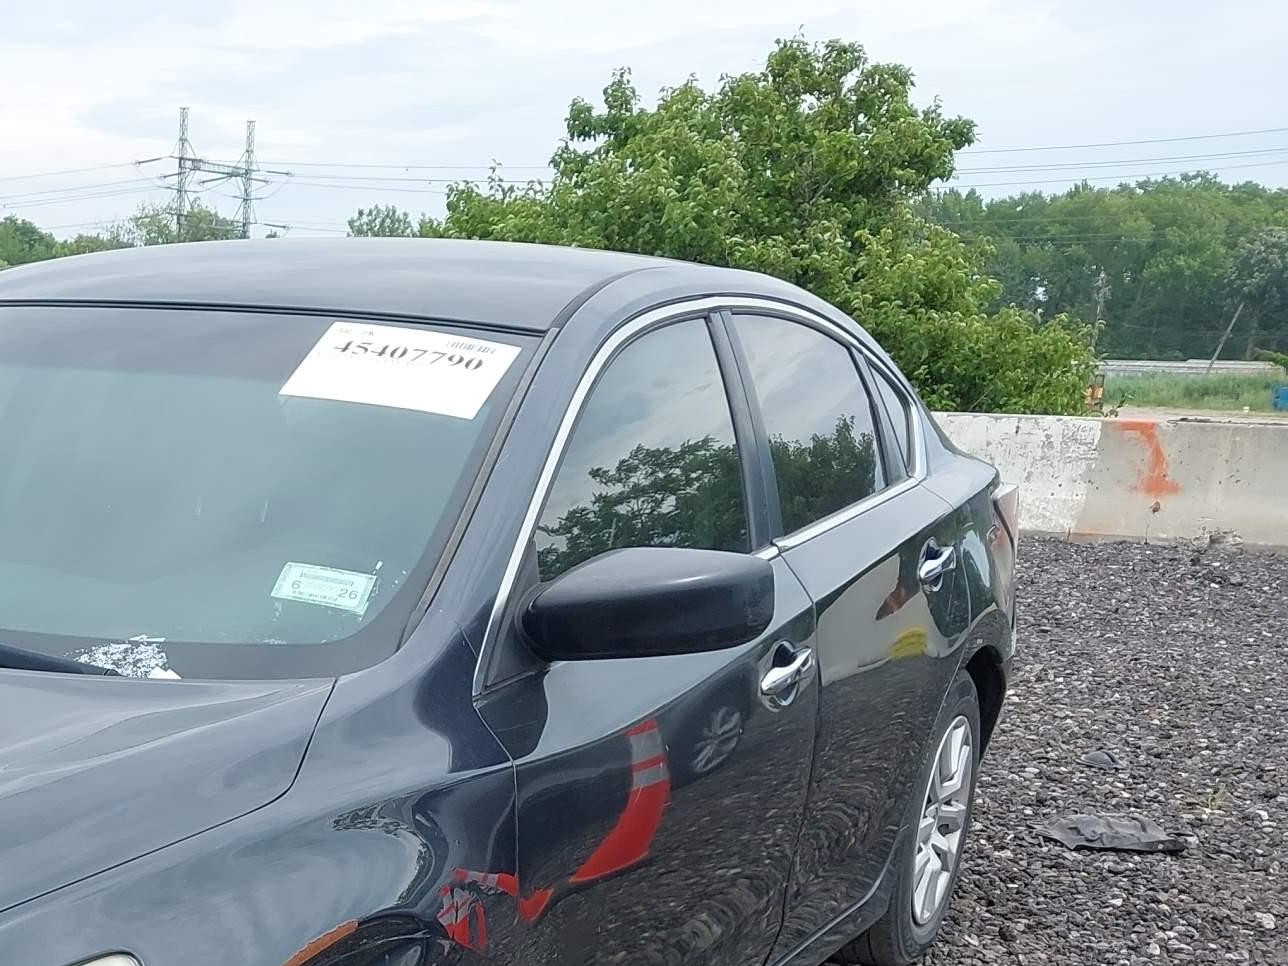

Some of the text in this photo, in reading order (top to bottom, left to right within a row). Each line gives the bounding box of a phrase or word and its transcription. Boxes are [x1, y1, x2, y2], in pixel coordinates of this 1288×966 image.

[335, 340, 483, 370] 45407790
[291, 581, 301, 589] 6
[337, 588, 359, 600] 26
